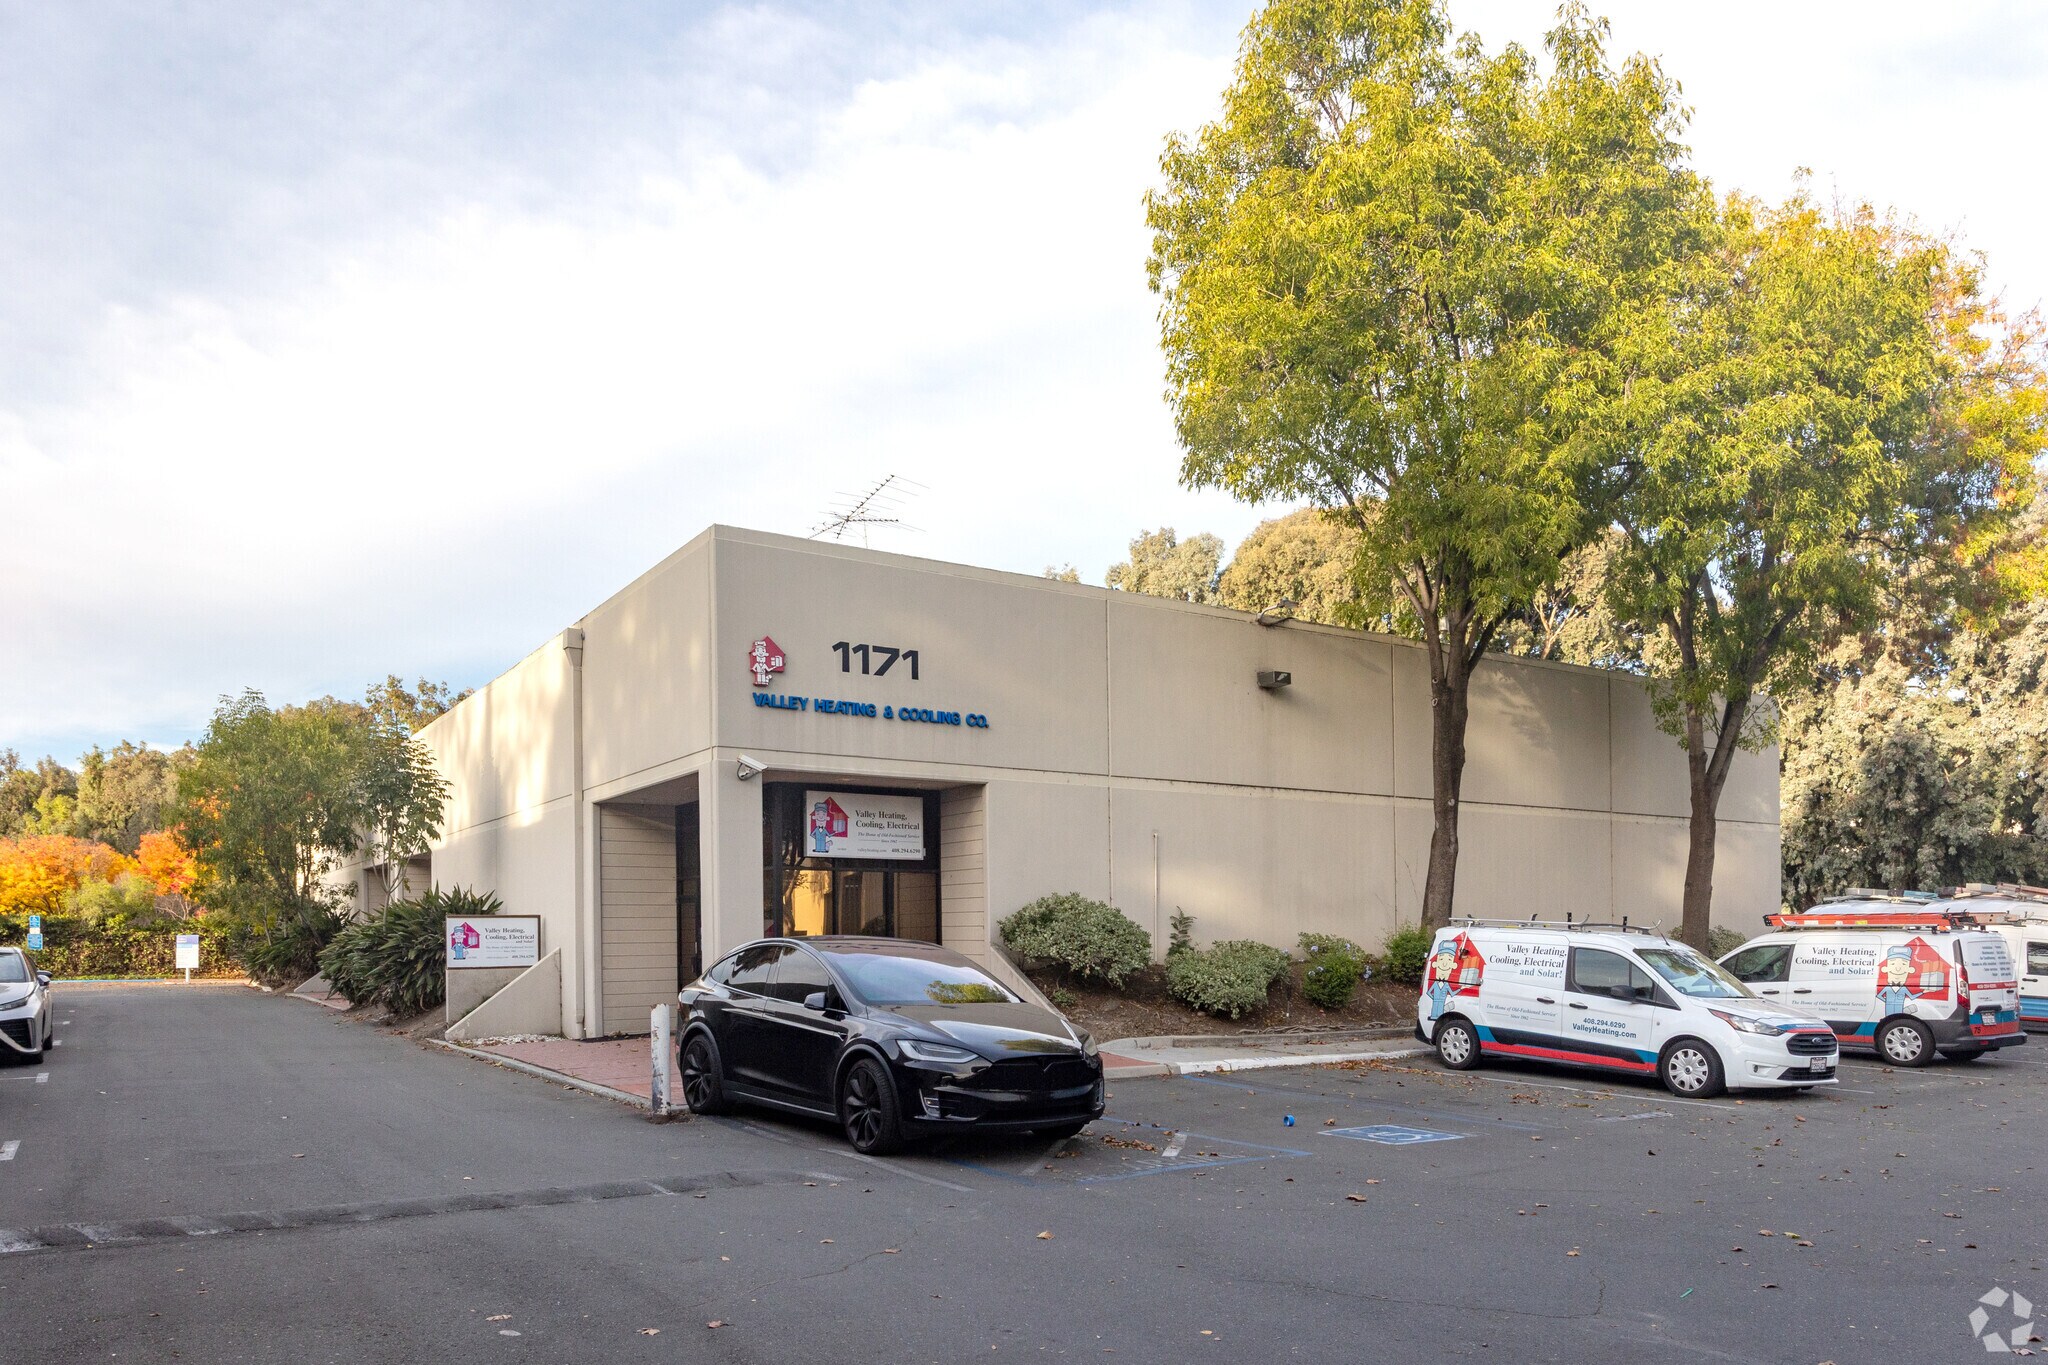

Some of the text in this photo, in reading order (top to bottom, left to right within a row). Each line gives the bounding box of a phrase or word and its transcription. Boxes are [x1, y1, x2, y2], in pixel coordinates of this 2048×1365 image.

[832, 641, 919, 680] 1171
[752, 692, 989, 728] VALLEY HEATING & COOLING CO.
[855, 810, 907, 820] Valley Heating,
[855, 820, 920, 830] Cooling, Electrical
[1507, 944, 1567, 957] Valley Heating,
[1812, 947, 1877, 957] Valley Heating,
[1489, 955, 1565, 968] Cooling, Electrical
[1795, 957, 1875, 966] Cooling, Electrical
[1537, 969, 1563, 978] Solar!
[1847, 967, 1874, 975] Solar!
[1583, 1017, 1626, 1029] 408.294.6290
[1572, 1023, 1637, 1038] ValleyHeating.com
